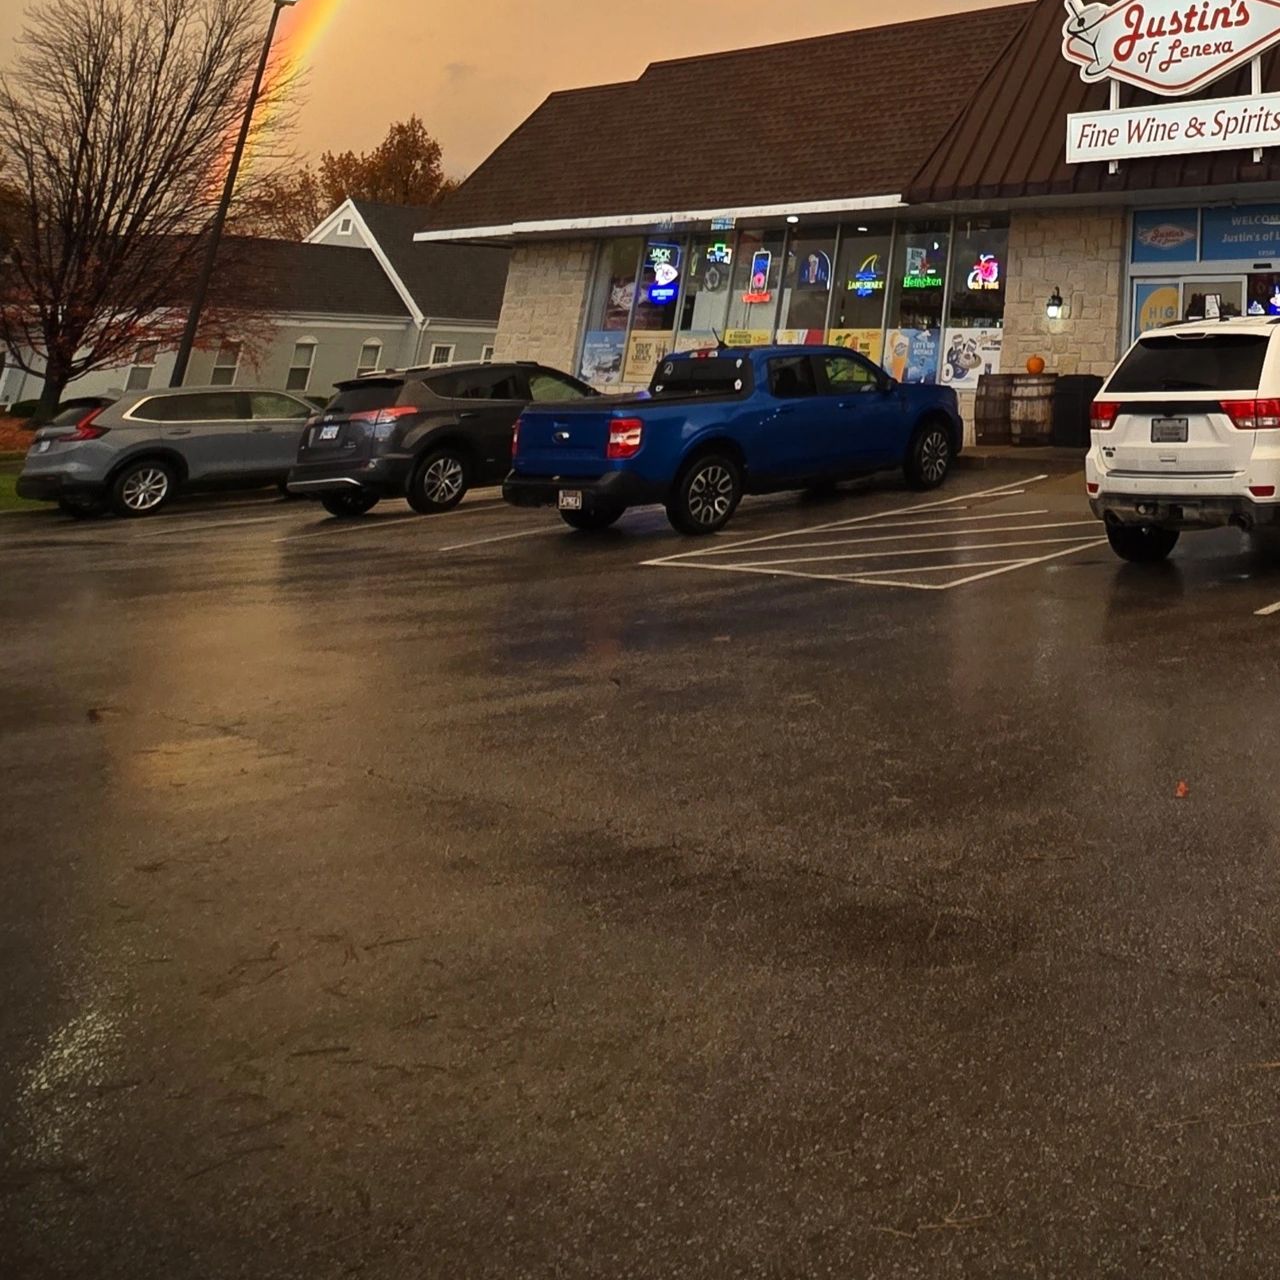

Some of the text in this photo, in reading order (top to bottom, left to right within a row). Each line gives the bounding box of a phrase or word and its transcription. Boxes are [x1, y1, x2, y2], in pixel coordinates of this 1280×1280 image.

[1137, 38, 1234, 73] of Lenexa
[1076, 122, 1120, 149] Fine
[1127, 117, 1179, 144] Wine
[1184, 116, 1206, 138] &
[1221, 232, 1260, 243] Justin's
[1262, 231, 1274, 241] of
